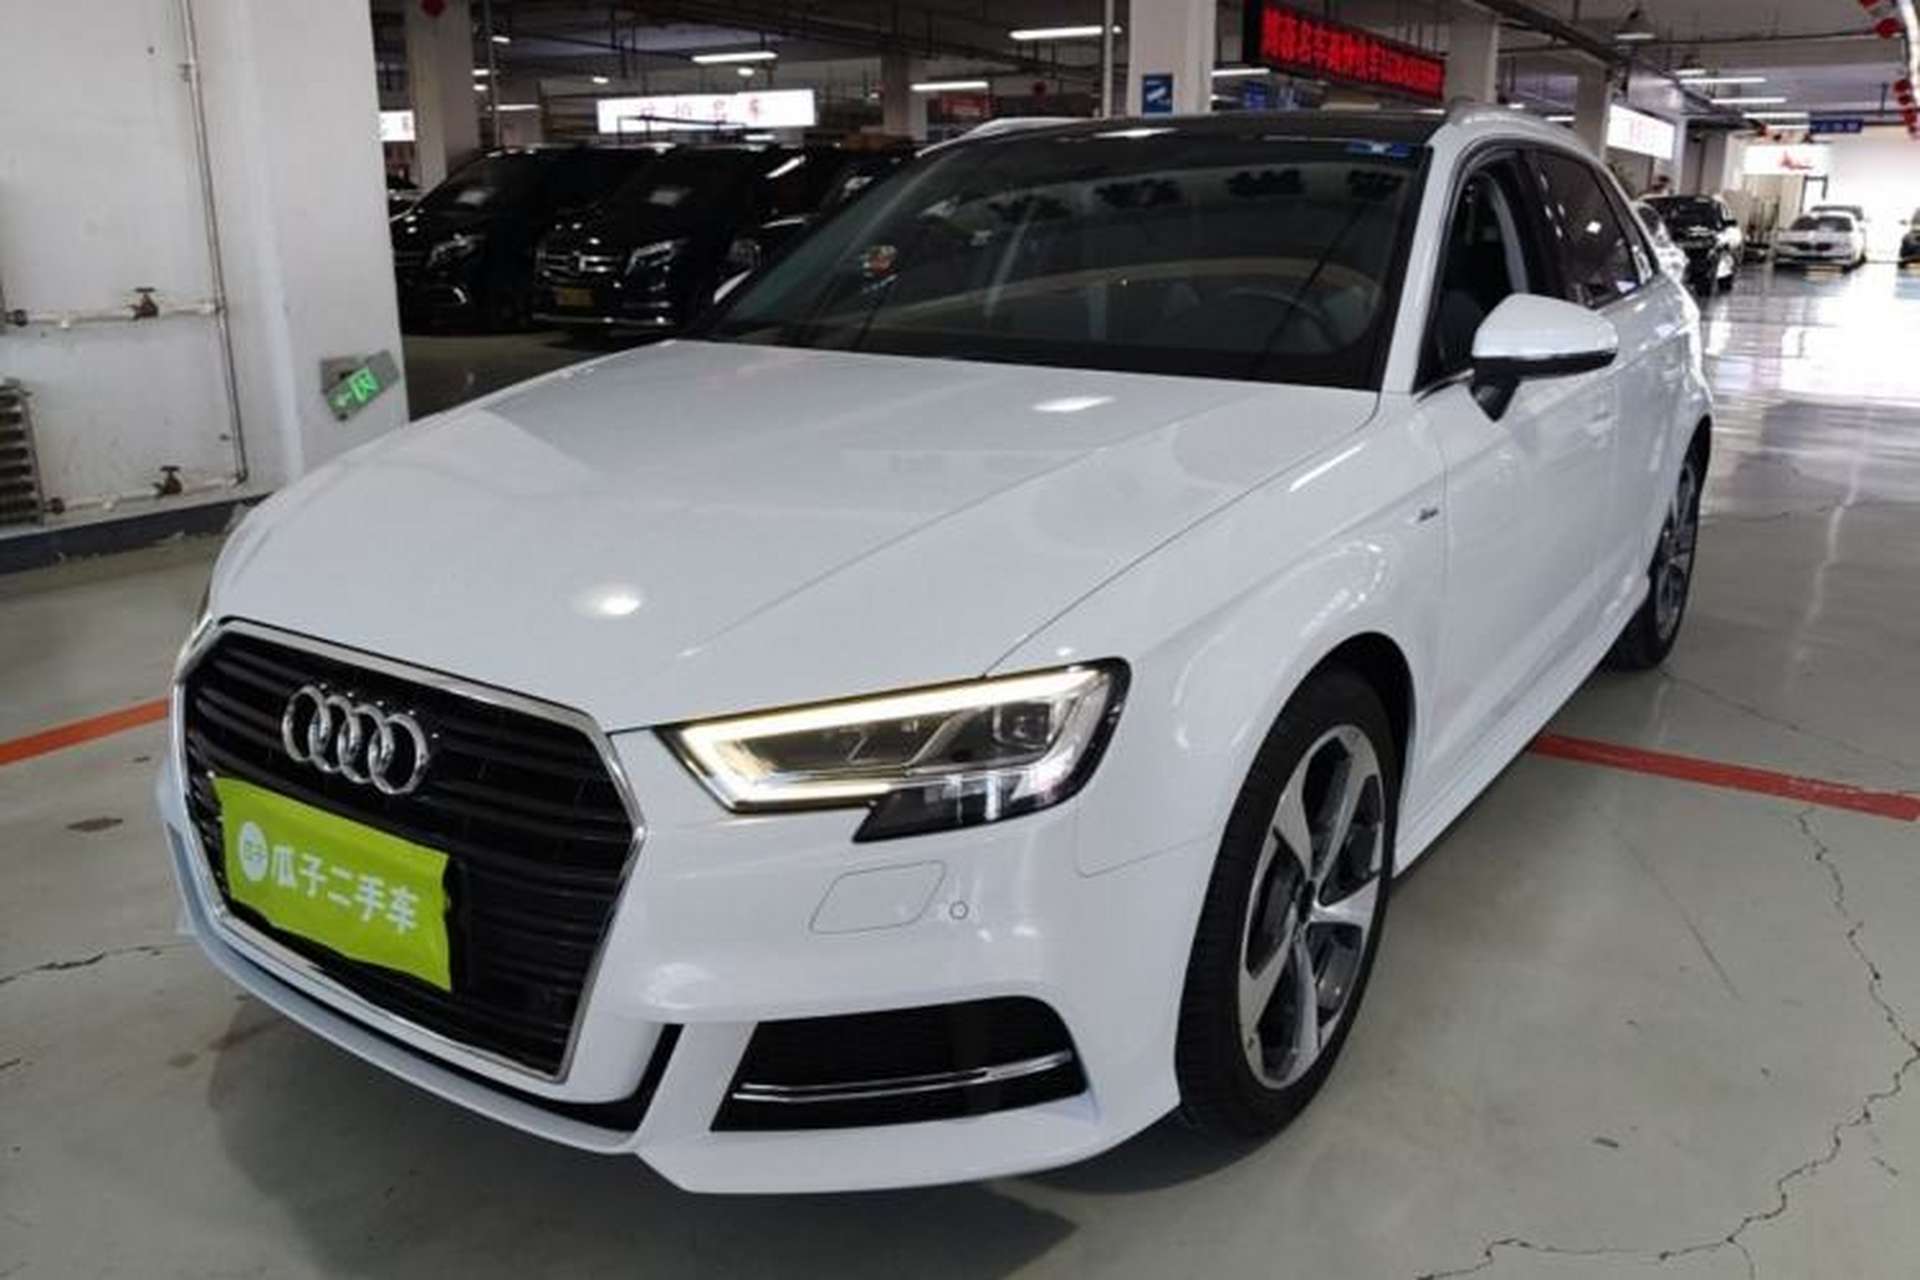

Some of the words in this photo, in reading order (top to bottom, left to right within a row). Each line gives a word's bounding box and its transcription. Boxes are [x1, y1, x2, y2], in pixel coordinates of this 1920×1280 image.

[272, 845, 419, 933] 瓜子二手车
